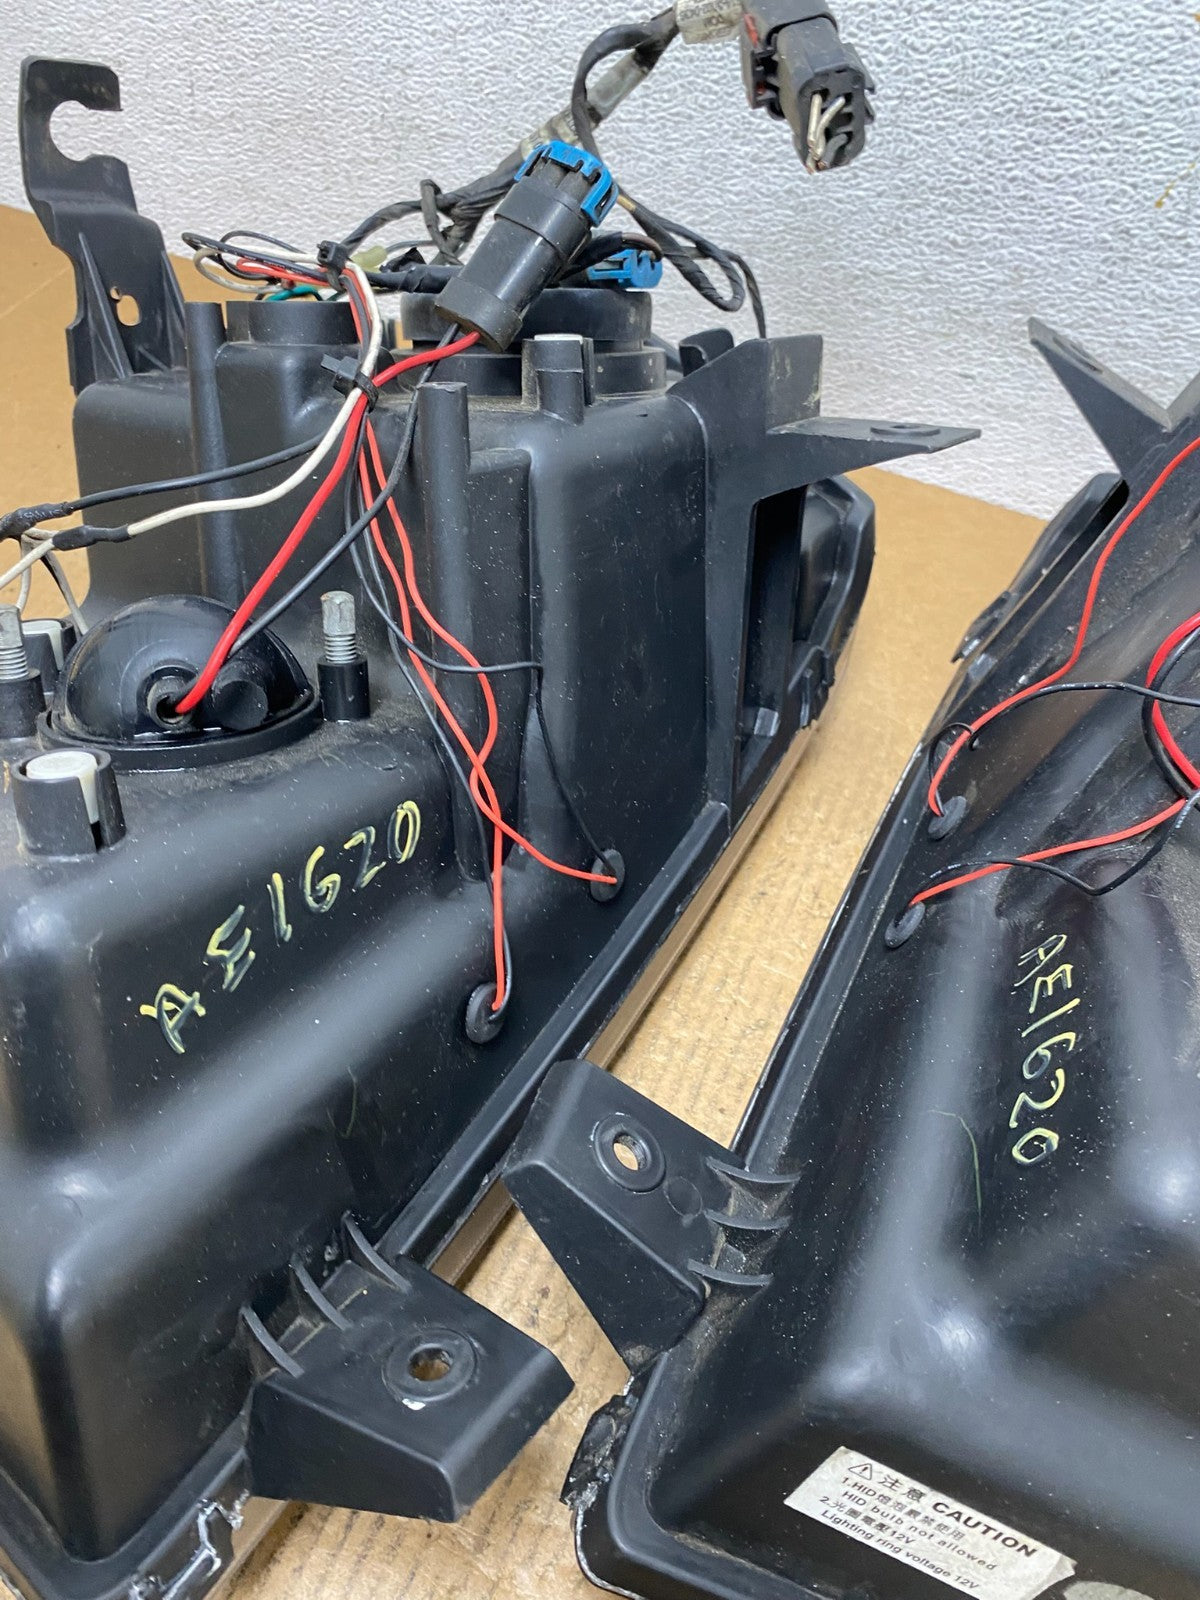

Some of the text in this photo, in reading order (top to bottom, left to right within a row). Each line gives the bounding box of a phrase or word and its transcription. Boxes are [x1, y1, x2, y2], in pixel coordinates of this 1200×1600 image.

[1009, 934, 1082, 1166] AE1620
[821, 1509, 981, 1590] Lighting ring voltage 12V
[842, 1491, 998, 1570] HID bulb not allowed
[878, 1475, 1037, 1557] 注意 CAUTION
